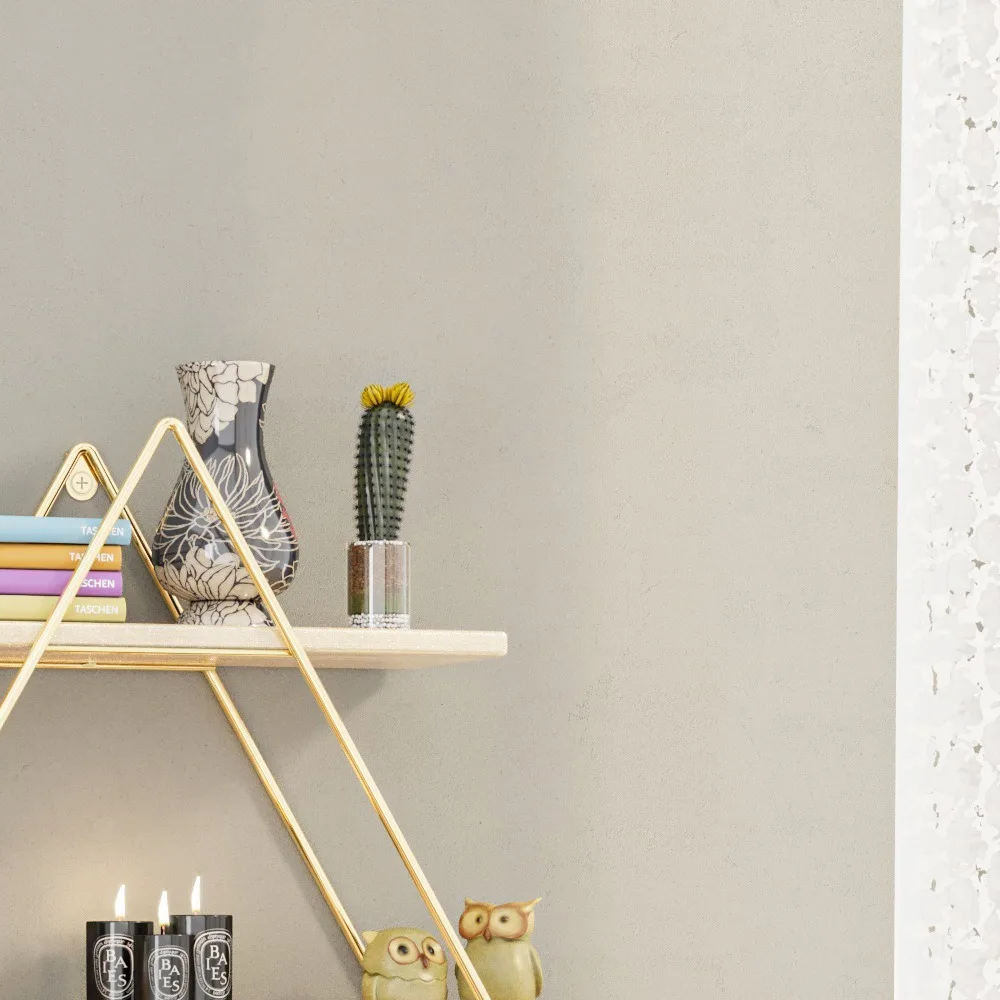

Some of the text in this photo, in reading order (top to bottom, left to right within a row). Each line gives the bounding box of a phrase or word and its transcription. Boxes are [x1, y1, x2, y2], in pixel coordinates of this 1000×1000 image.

[80, 526, 124, 536] TASEN
[79, 579, 115, 589] SCHEN
[74, 604, 119, 614] TASCHEN
